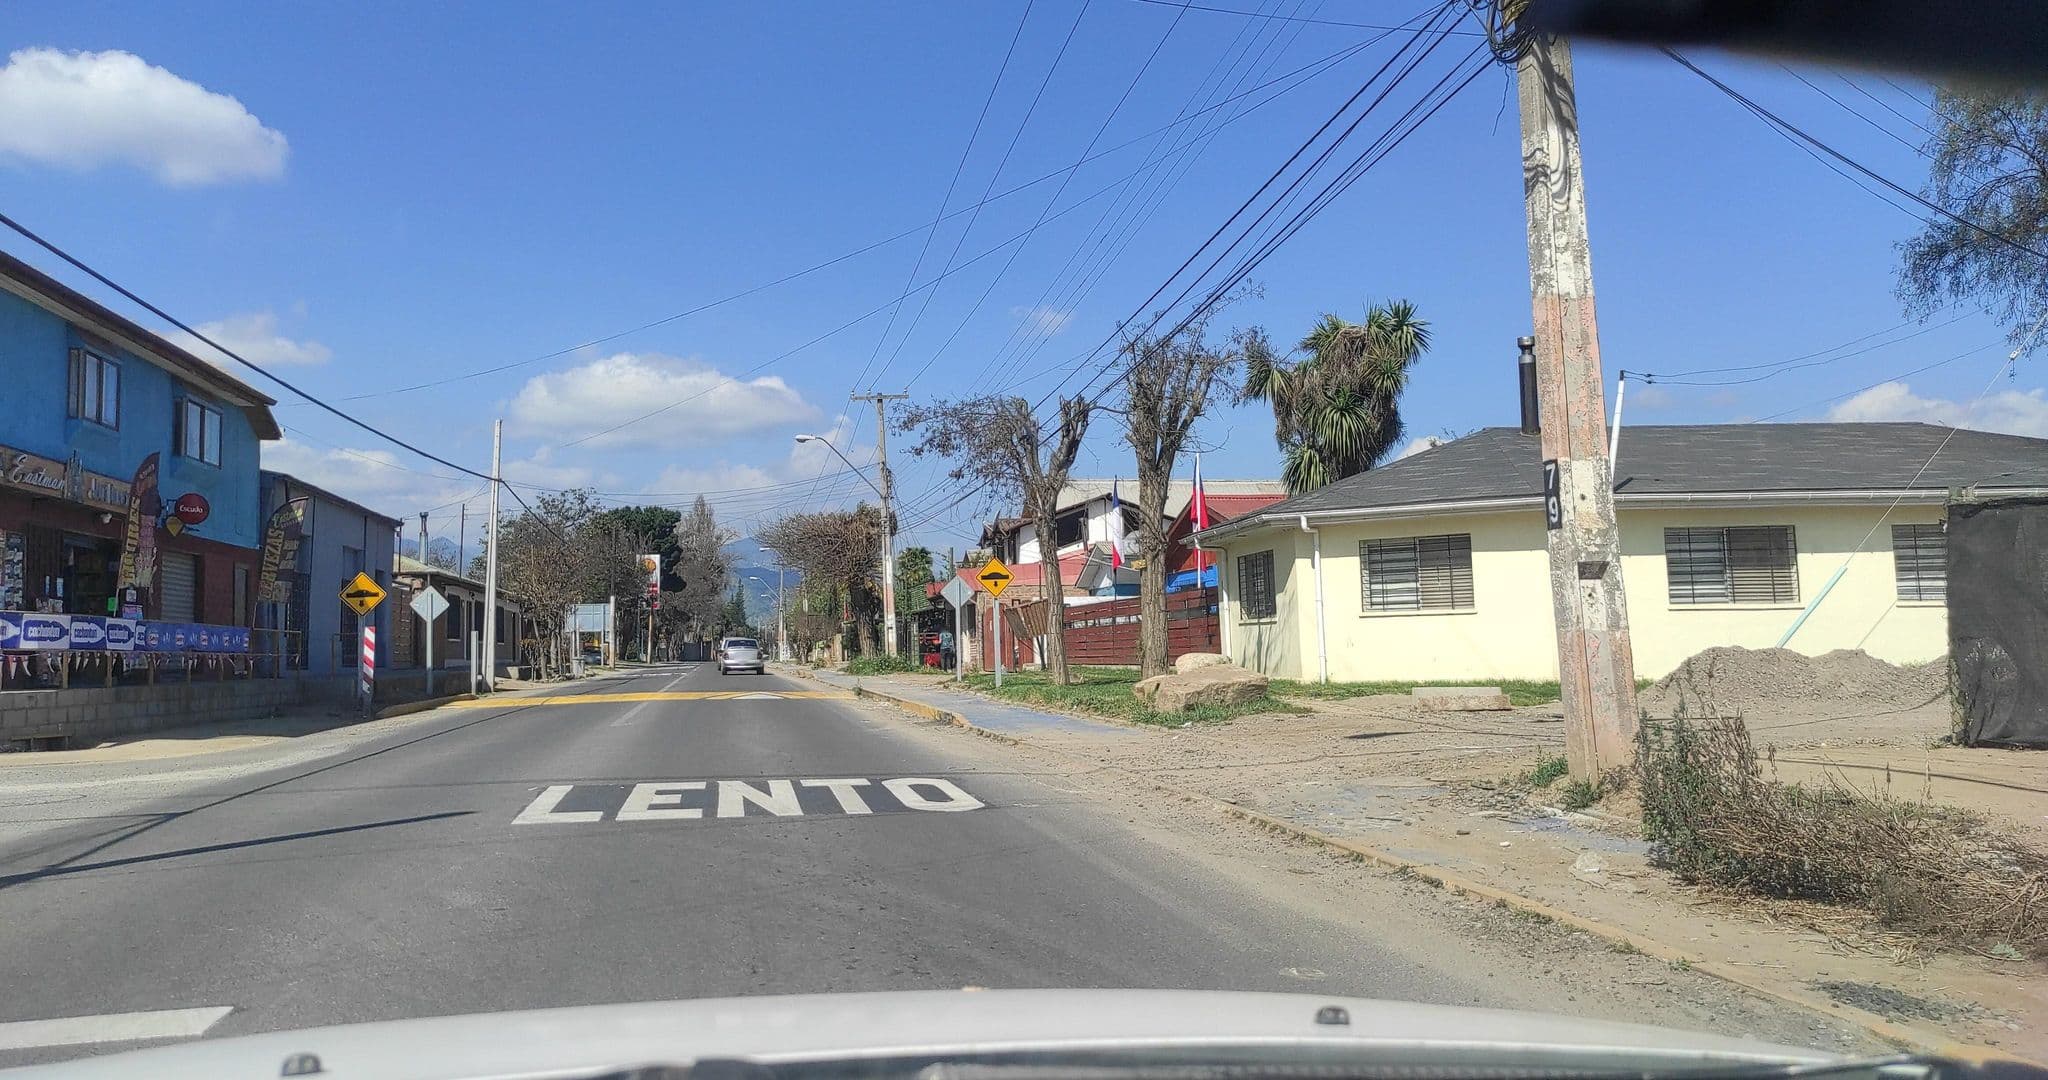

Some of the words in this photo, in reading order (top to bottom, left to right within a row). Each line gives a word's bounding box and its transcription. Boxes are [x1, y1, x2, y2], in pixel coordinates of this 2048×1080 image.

[9, 454, 65, 490] Eastman
[1546, 463, 1559, 523] 79
[179, 505, 203, 514] Escudo
[259, 528, 285, 600] CERVEZAS
[511, 777, 986, 825] LENTO
